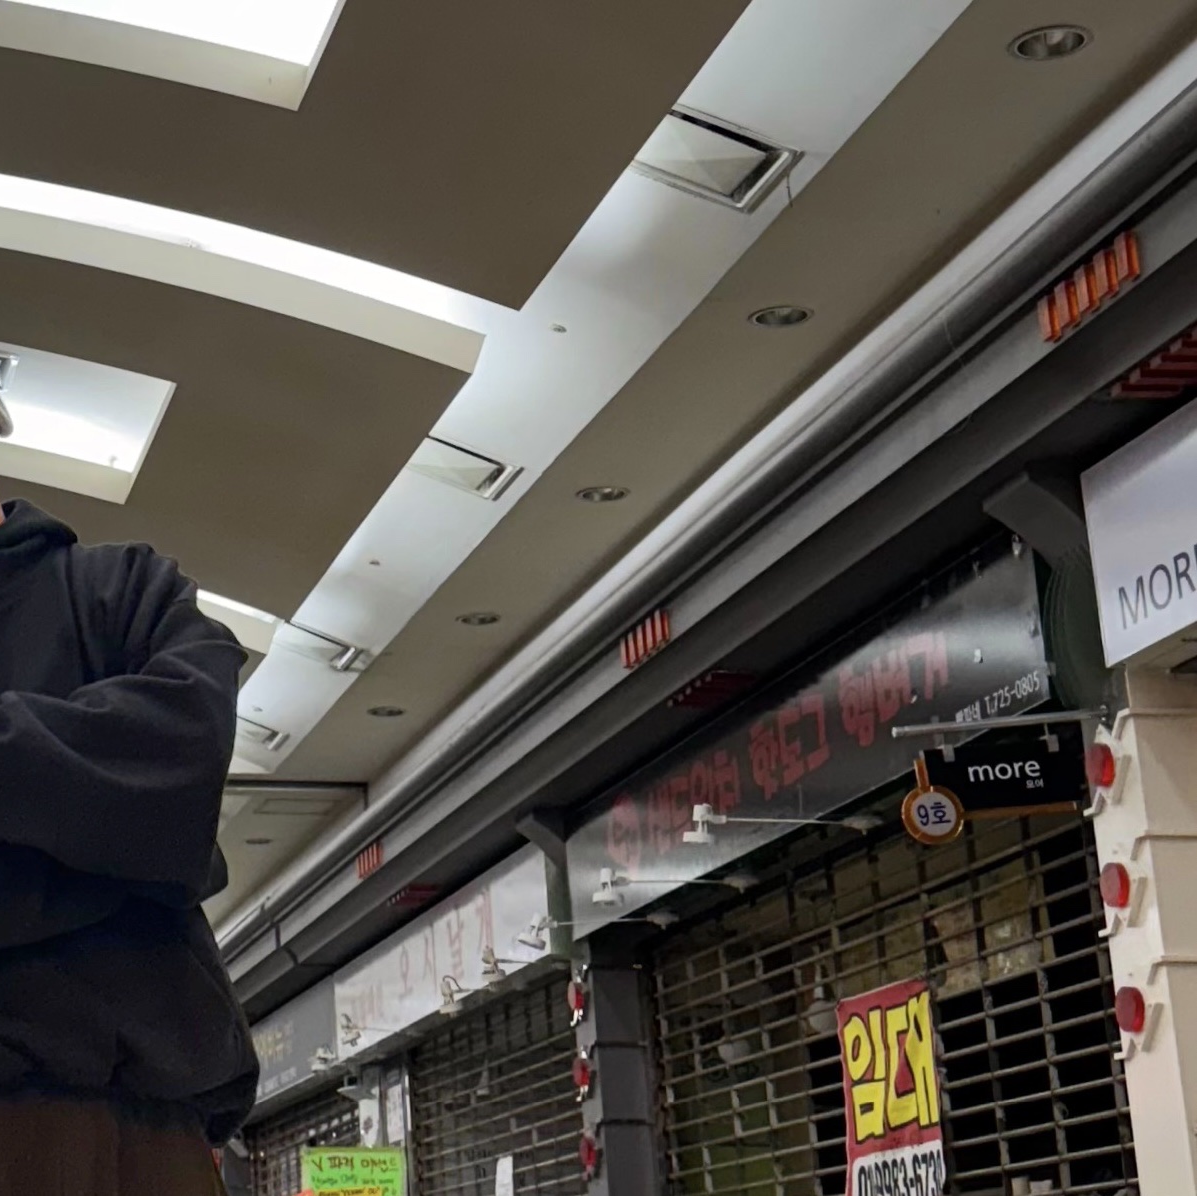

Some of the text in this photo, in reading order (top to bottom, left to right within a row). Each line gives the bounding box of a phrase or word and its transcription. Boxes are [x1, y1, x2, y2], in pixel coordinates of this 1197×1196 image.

[1118, 543, 1197, 630] MOR
[748, 689, 831, 800] 핫도그
[967, 760, 1041, 783] more
[1025, 778, 1045, 789] 모어
[916, 801, 952, 827] 9호
[842, 990, 940, 1143] 임대
